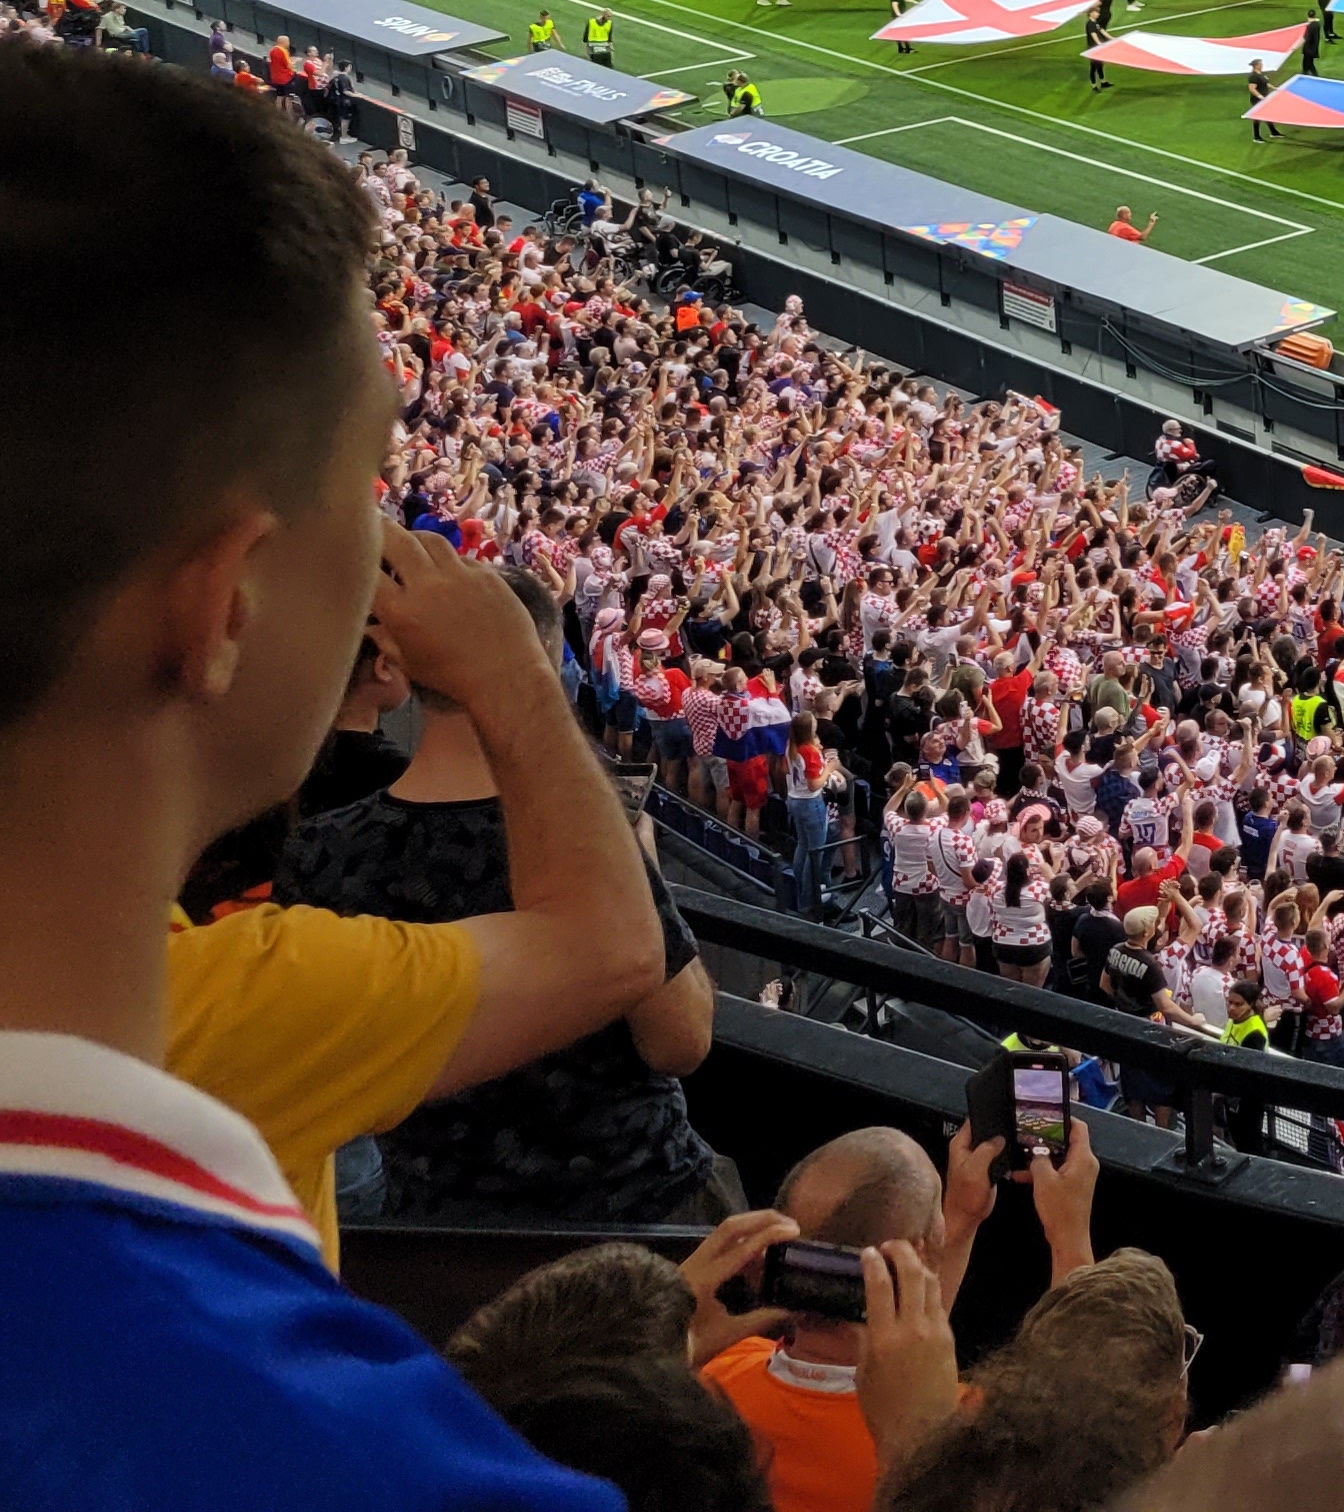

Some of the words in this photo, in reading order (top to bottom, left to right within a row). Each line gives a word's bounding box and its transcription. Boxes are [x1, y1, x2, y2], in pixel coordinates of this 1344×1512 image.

[373, 16, 438, 38] SPAIN
[566, 79, 629, 102] FINALS
[737, 140, 844, 181] CROATIA
